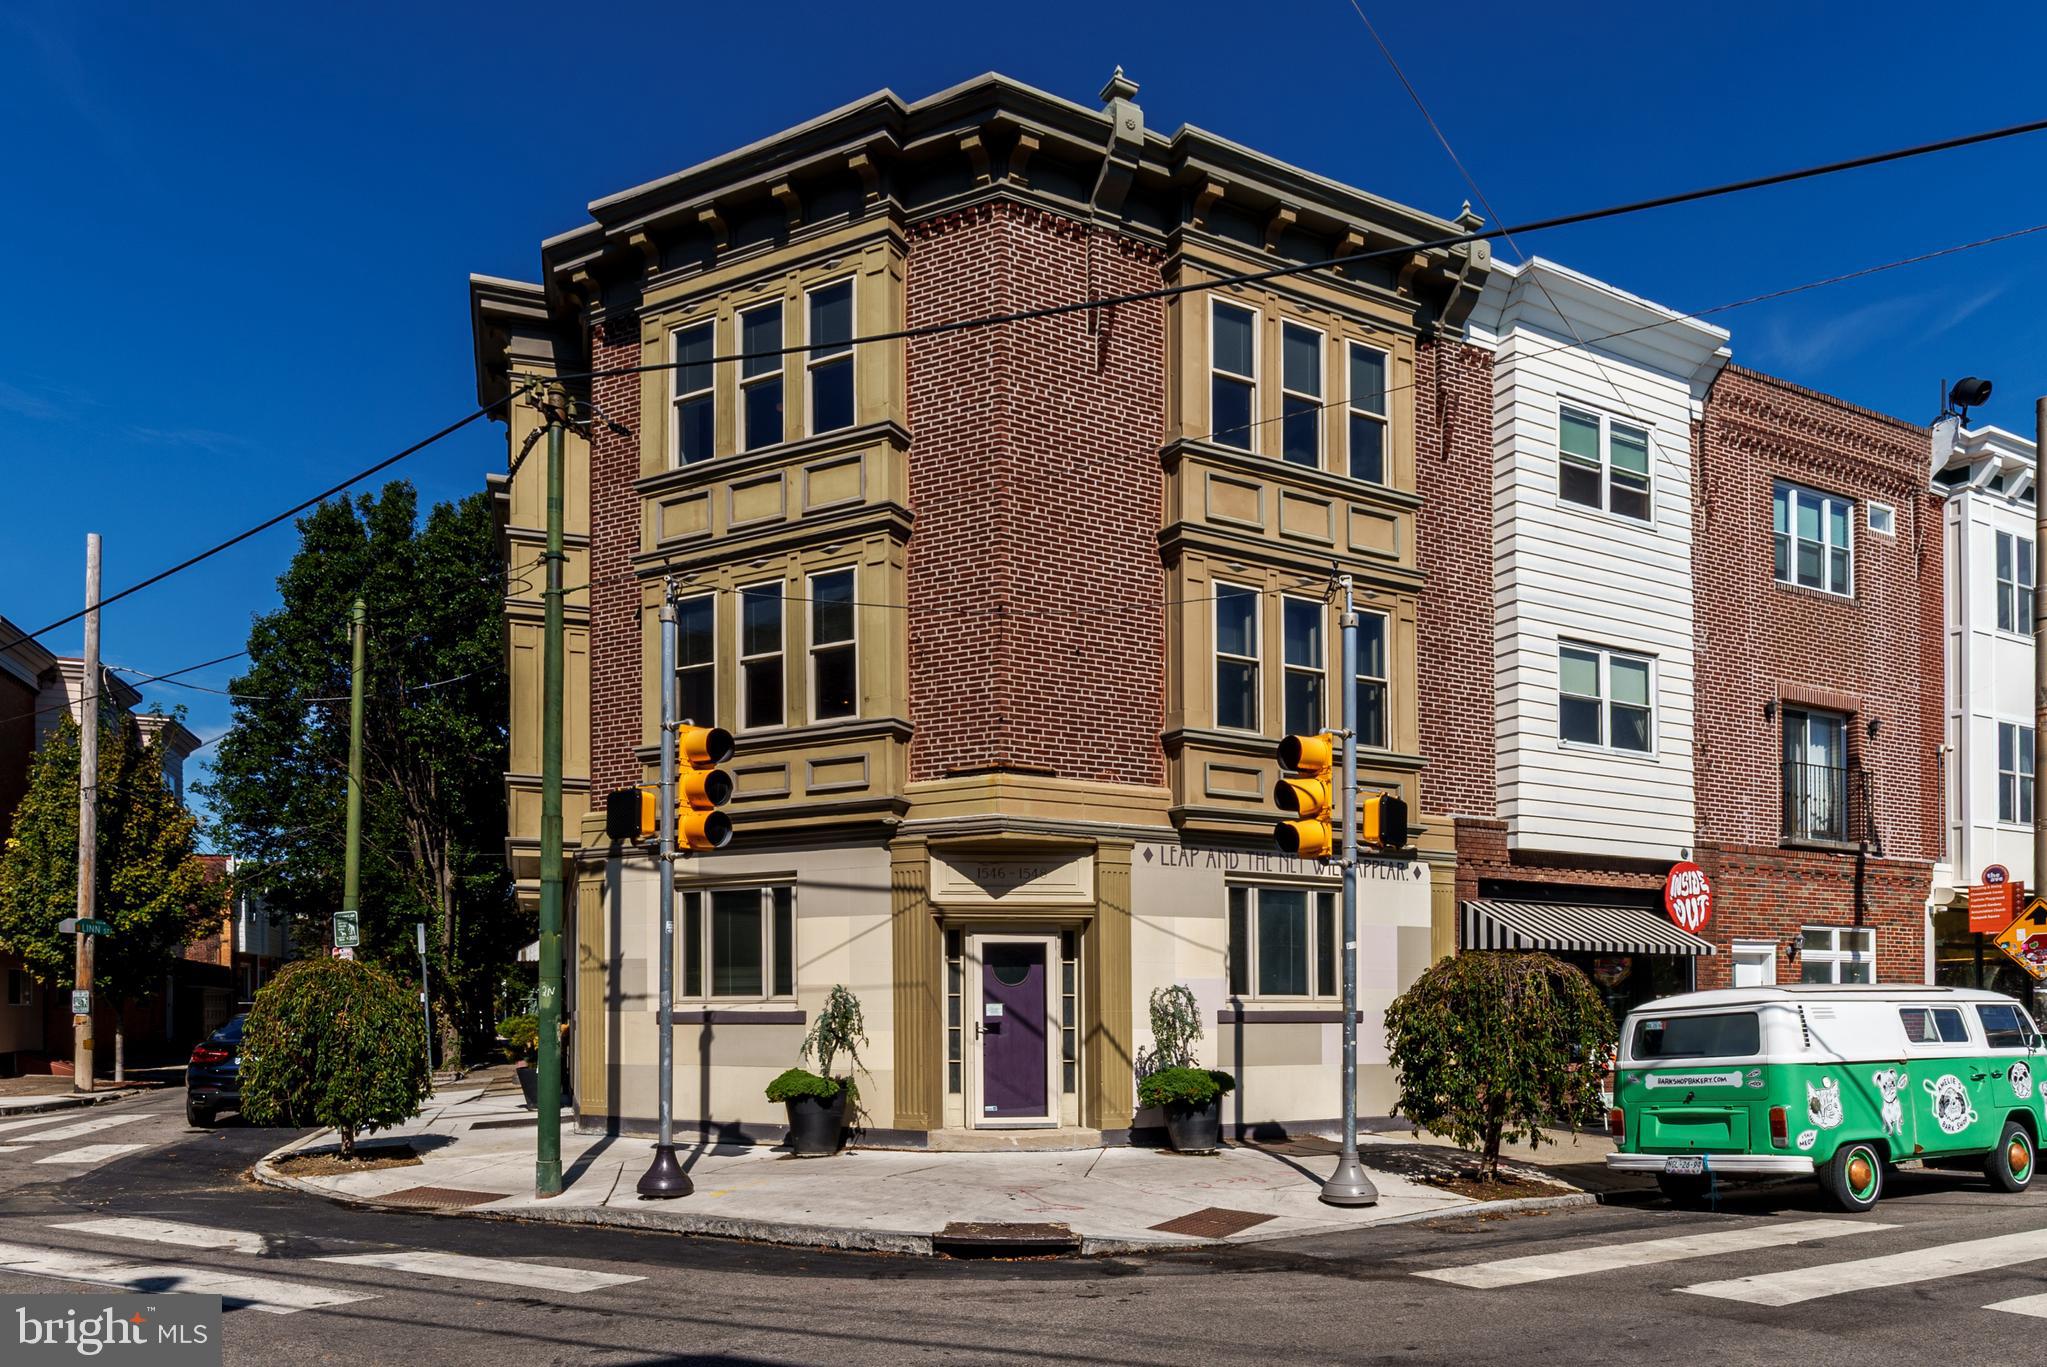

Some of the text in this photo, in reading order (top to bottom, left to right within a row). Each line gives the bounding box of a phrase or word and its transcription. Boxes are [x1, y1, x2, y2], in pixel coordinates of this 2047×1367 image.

[1160, 845, 1409, 881] LEAP AND THE NET WIL APPEAR.
[977, 867, 1006, 880] 1546
[1670, 871, 1710, 898] INSIDE
[1673, 894, 1710, 931] OUT
[82, 923, 101, 934] LINN
[1657, 1076, 1727, 1085] BARKSHOPBAKERY.COM
[1937, 1076, 1961, 1091] AMELIE'S
[1942, 1116, 1968, 1131] BARK SHOP
